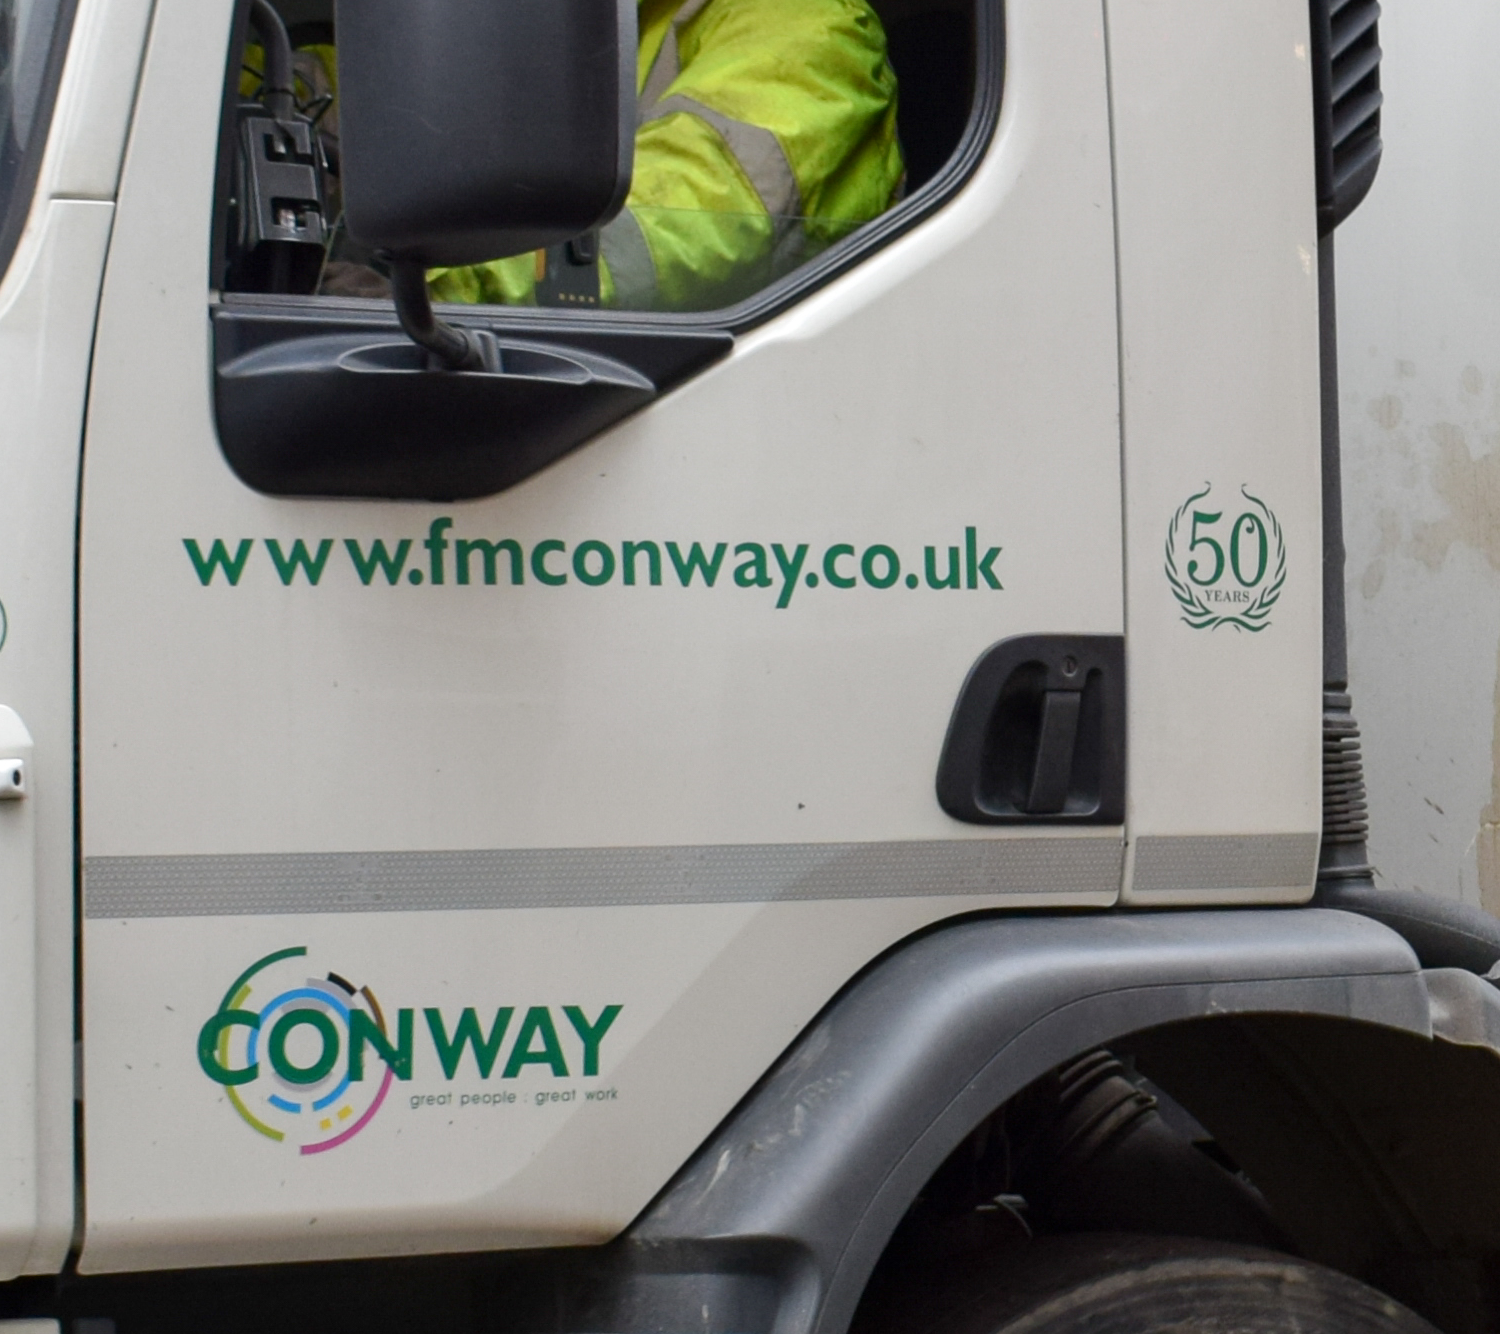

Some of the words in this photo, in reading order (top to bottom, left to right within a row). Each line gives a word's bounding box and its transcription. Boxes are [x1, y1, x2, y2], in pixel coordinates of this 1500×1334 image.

[182, 517, 1004, 610] www.fmconway.co.uk
[1187, 510, 1268, 588] 50
[1204, 590, 1250, 603] YEARS
[197, 1004, 624, 1086] CONWAY
[410, 1093, 452, 1109] great
[460, 1090, 516, 1106] people
[535, 1088, 576, 1105] great
[585, 1086, 618, 1101] work
